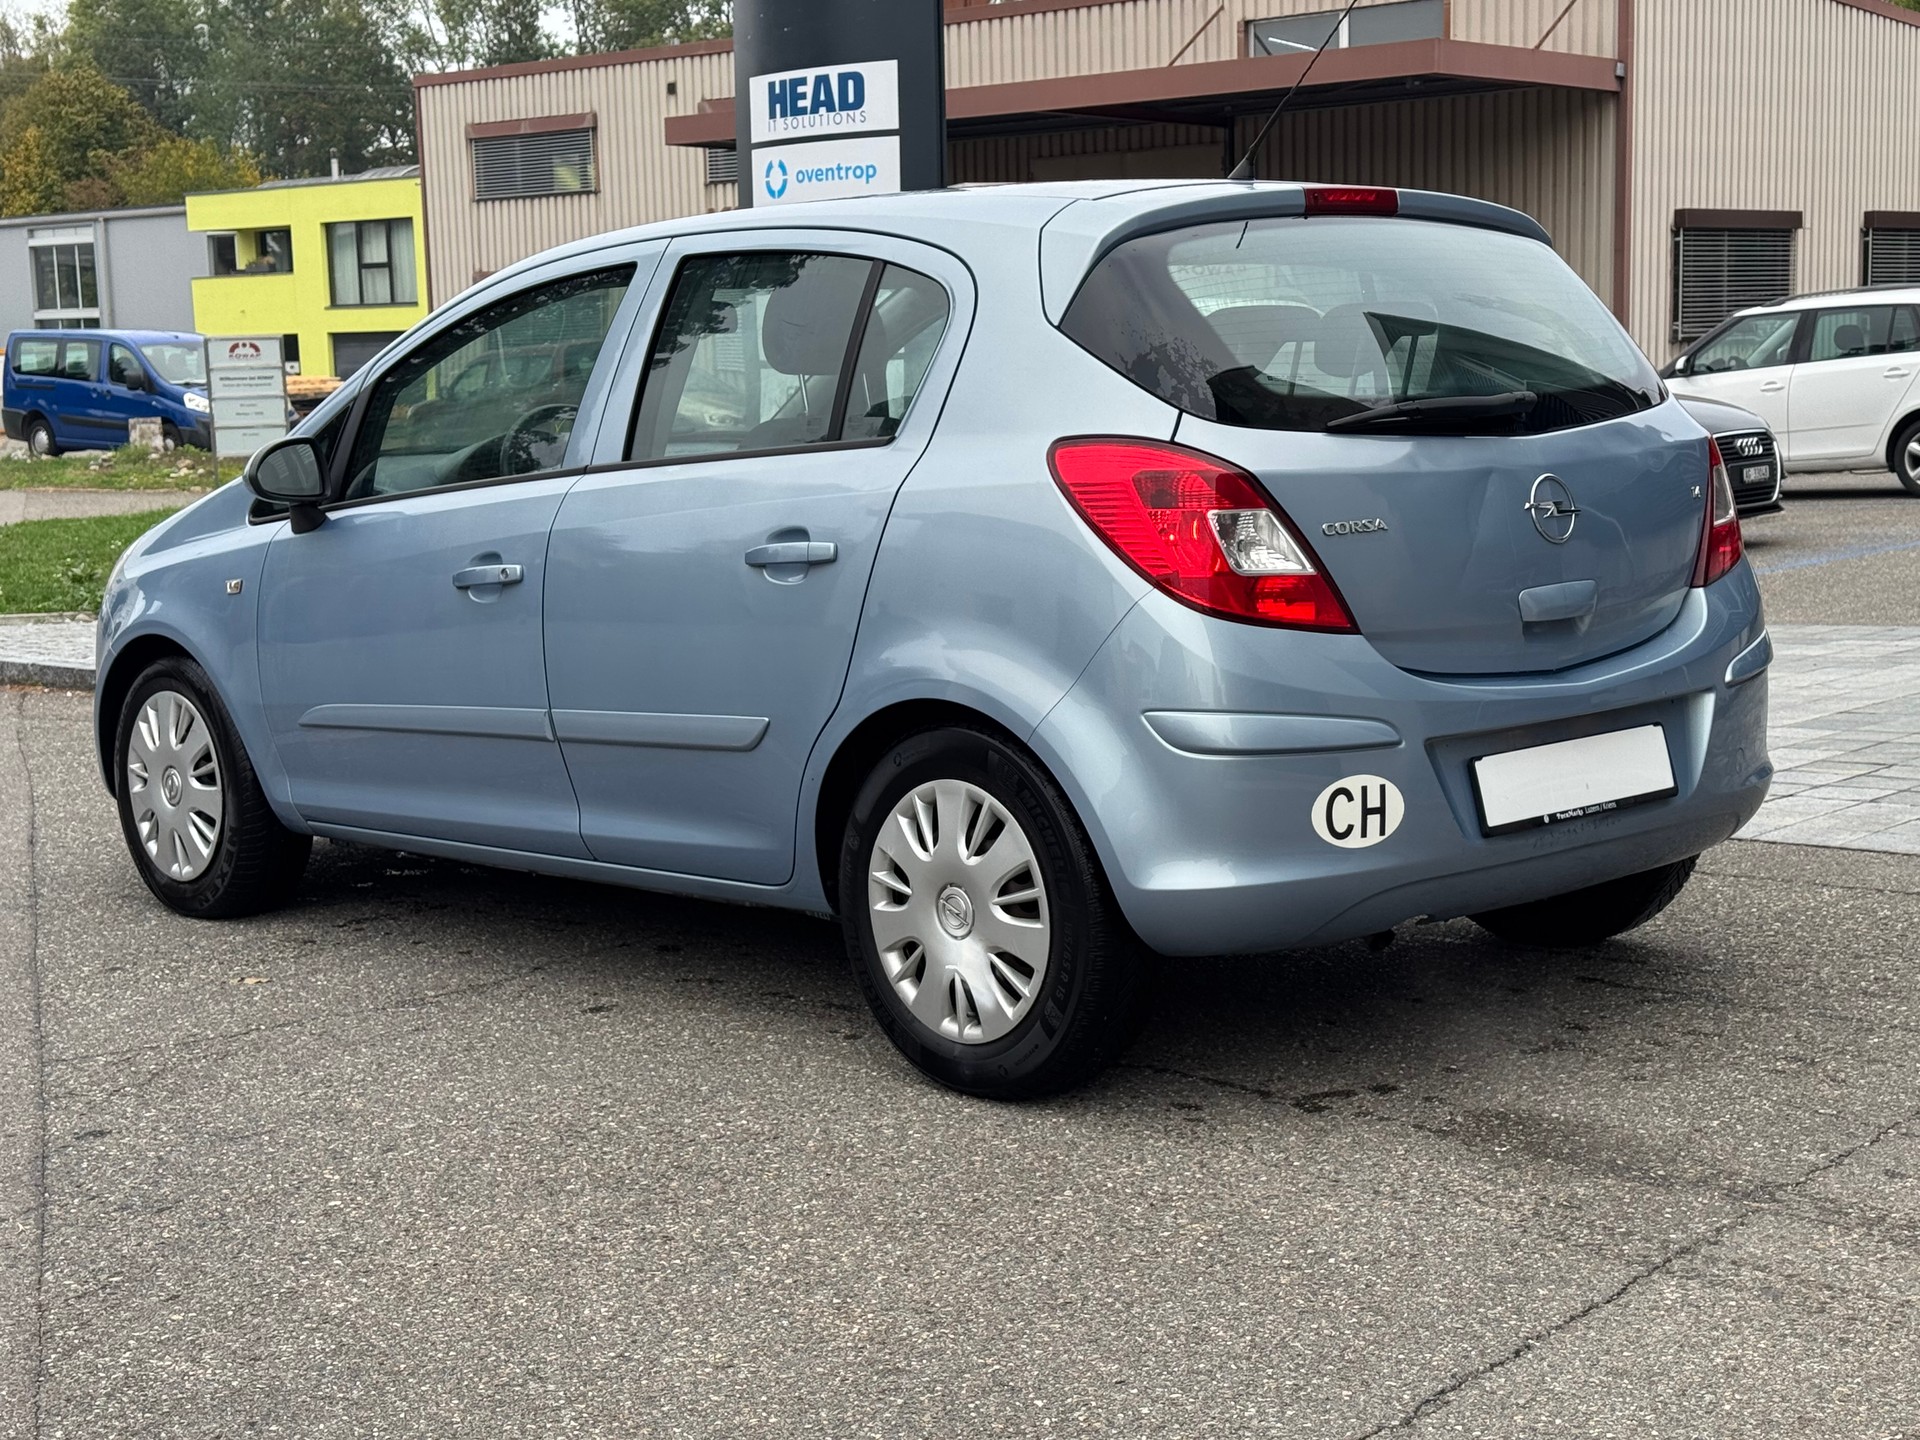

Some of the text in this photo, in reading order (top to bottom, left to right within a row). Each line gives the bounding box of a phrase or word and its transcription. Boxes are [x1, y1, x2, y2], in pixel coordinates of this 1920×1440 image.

[768, 71, 865, 120] HEAD
[768, 110, 867, 132] IT SOLUTIONS
[796, 163, 877, 184] oventrop
[1322, 518, 1389, 536] CORSA
[1325, 783, 1386, 841] CH
